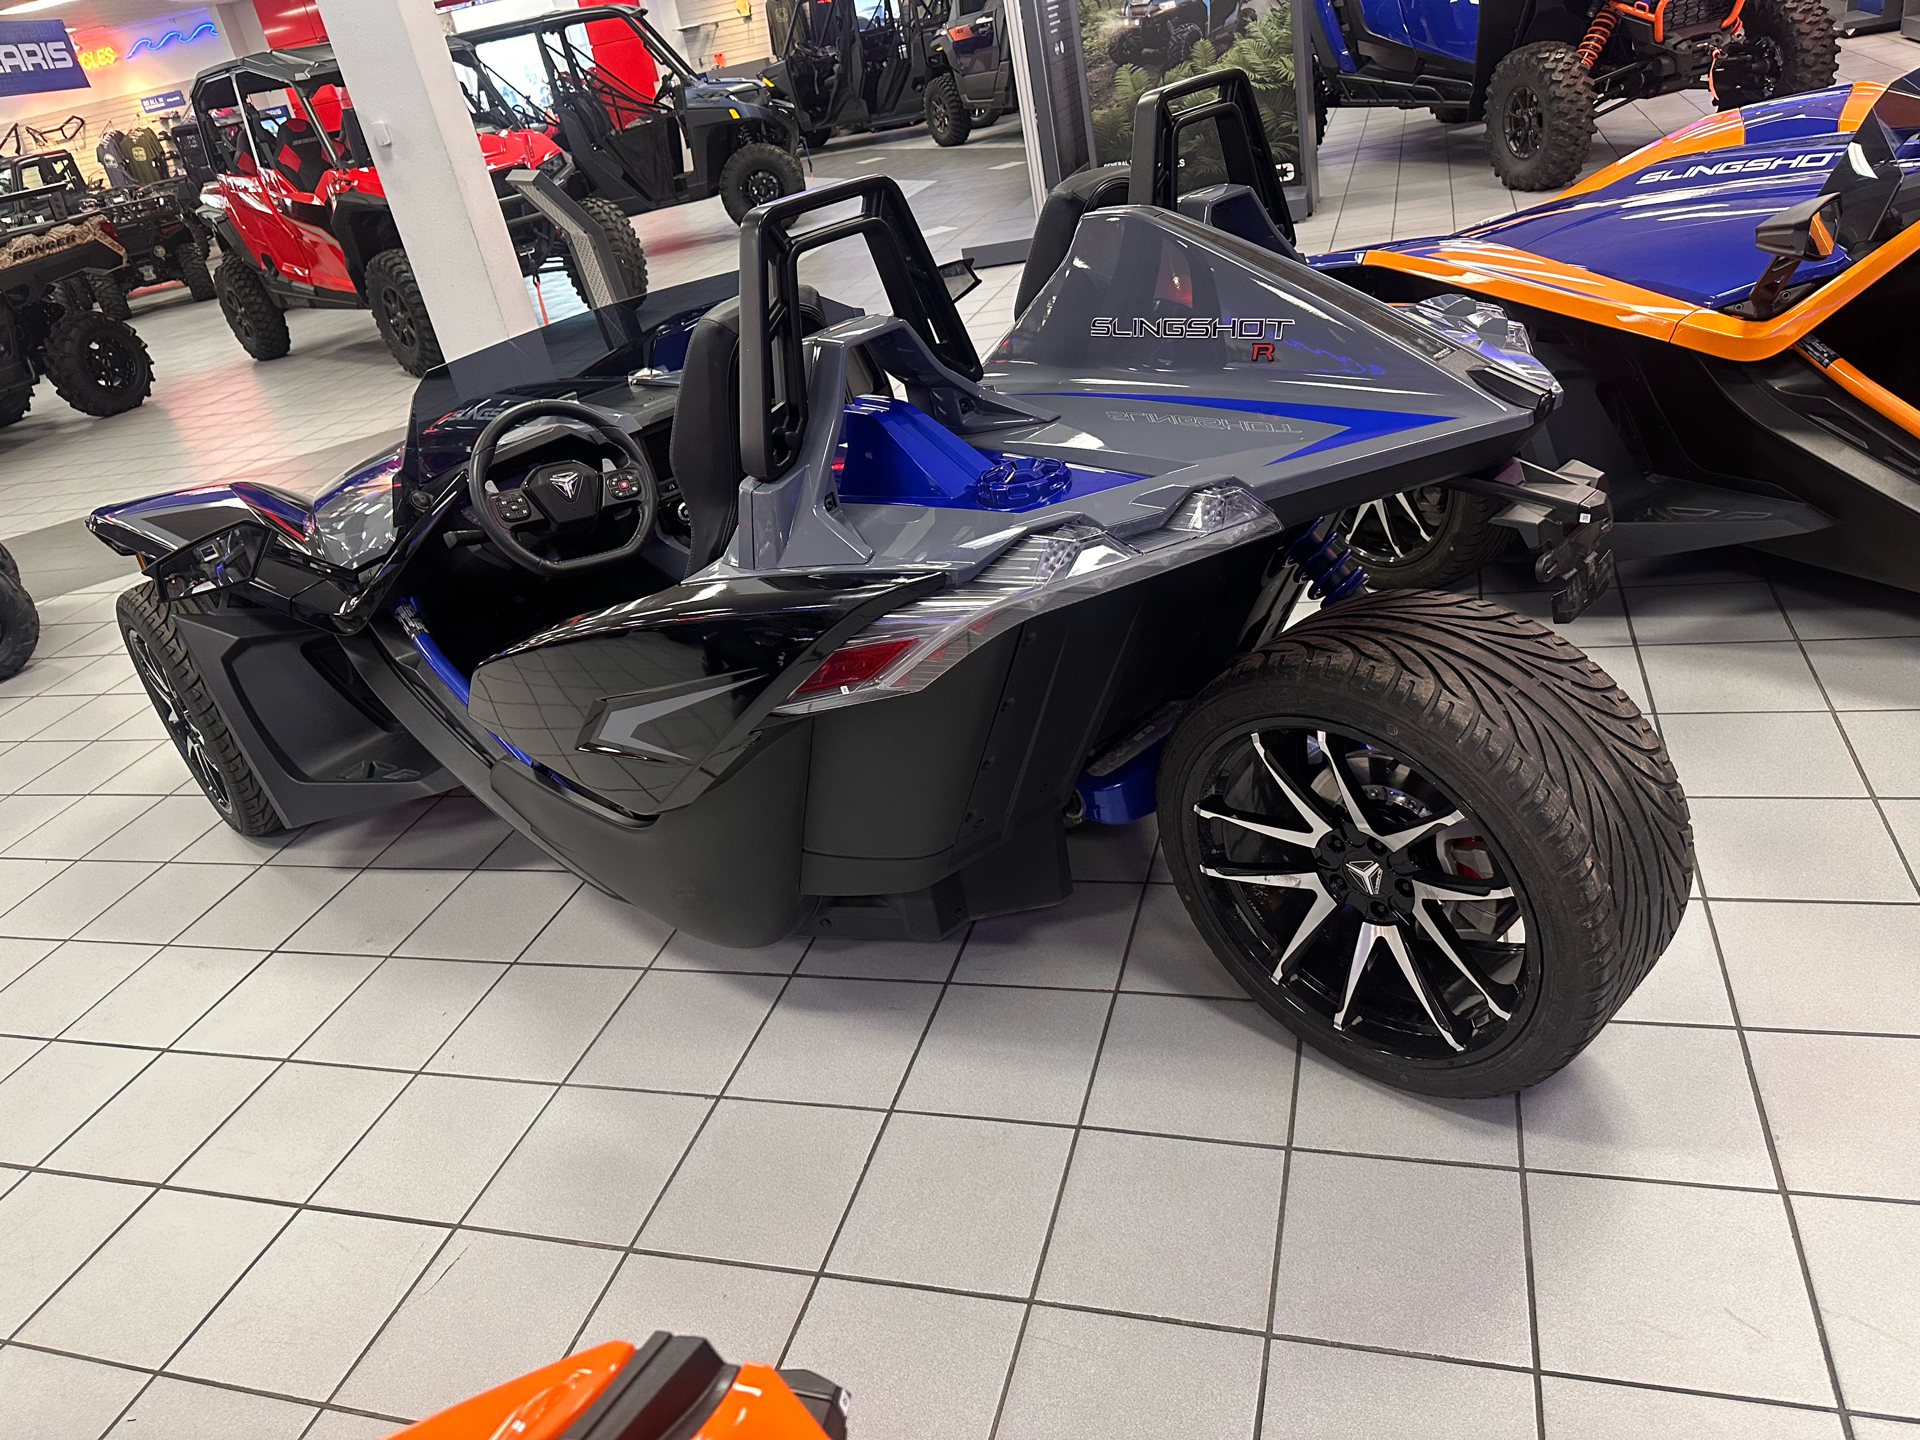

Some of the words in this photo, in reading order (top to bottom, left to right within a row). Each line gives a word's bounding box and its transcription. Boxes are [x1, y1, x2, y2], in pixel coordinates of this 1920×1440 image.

[78, 46, 117, 71] CLES
[13, 234, 76, 261] RANGER
[1090, 317, 1296, 340] SLINGSHOT
[1251, 343, 1275, 362] R
